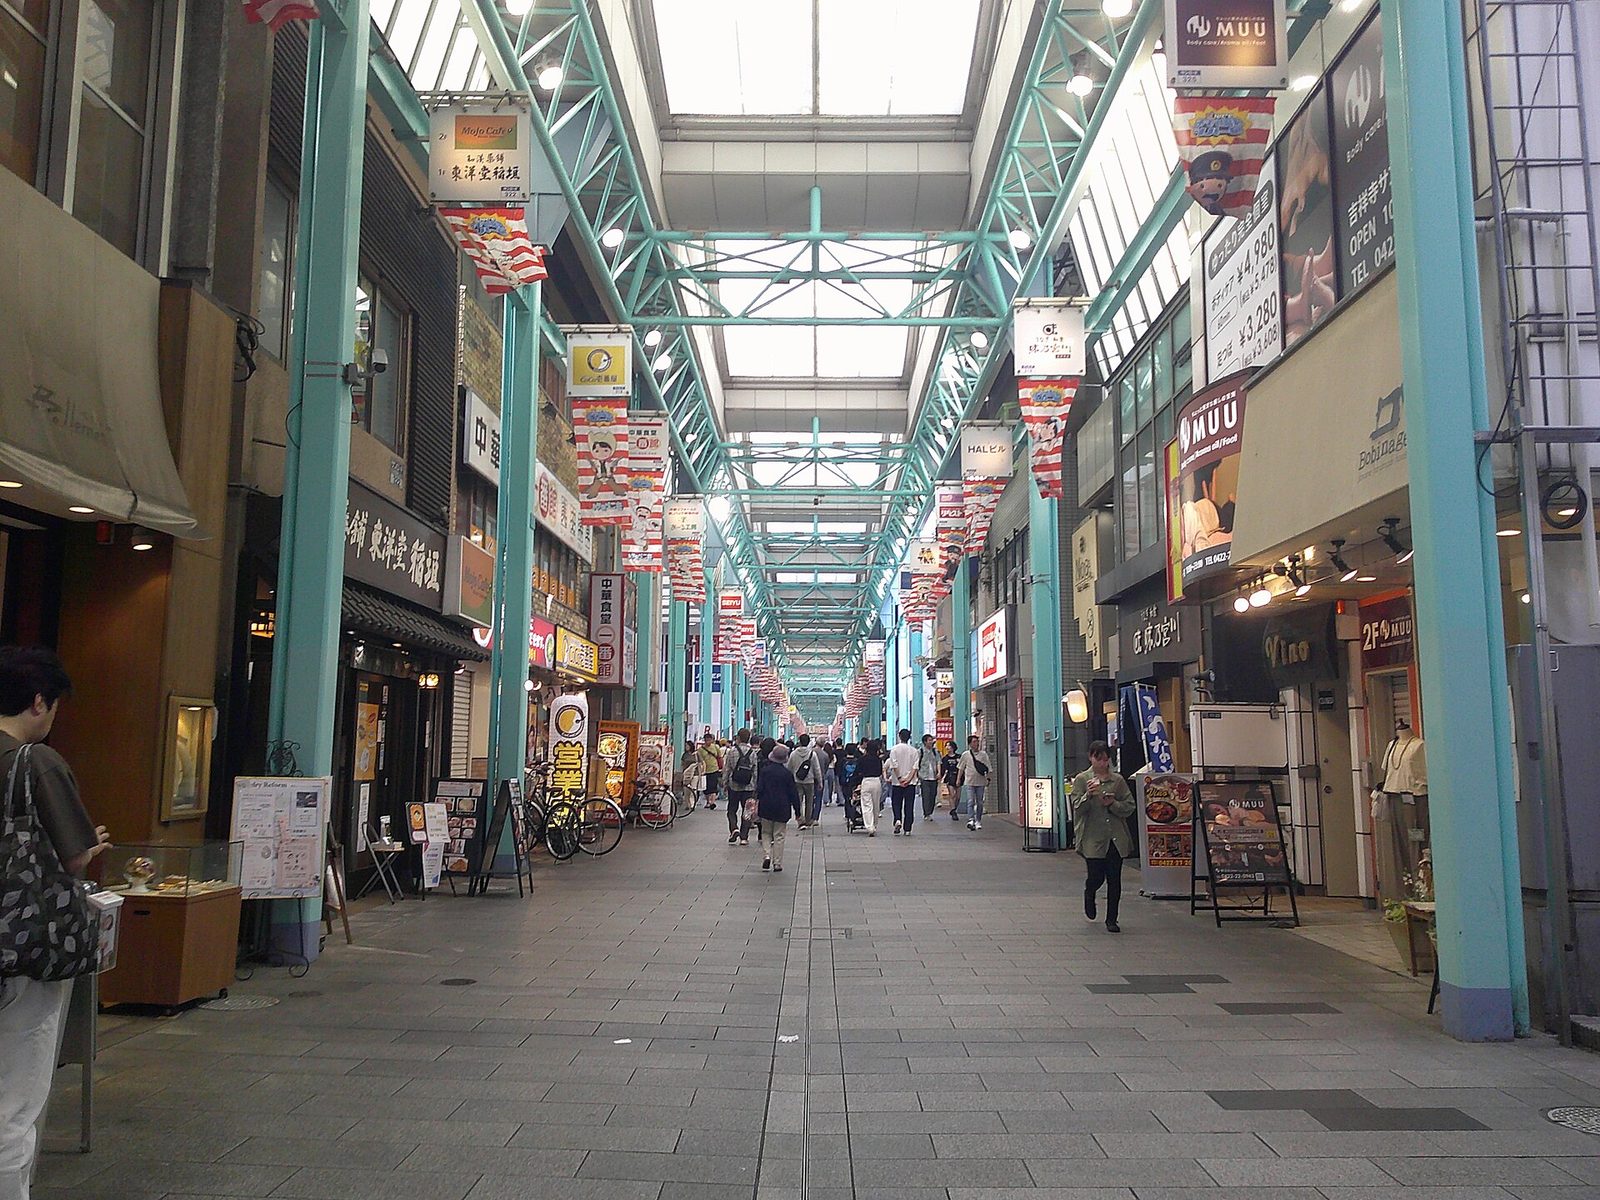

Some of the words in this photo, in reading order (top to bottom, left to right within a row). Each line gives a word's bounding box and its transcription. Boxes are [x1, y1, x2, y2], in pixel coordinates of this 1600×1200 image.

[1216, 22, 1265, 37] MUU
[462, 127, 485, 137] Mojo
[1237, 223, 1274, 285] ¥4,980
[1350, 217, 1377, 257] OPEN
[1351, 261, 1369, 288] TEL
[1239, 290, 1277, 349] ¥3,280
[1192, 400, 1237, 445] MUU
[967, 445, 1006, 454] HALビル
[600, 578, 612, 624] 中華食堂
[1362, 622, 1379, 650] 2F
[1391, 620, 1412, 637] MUU
[552, 741, 584, 818] 営業
[1242, 800, 1264, 808] MUU
